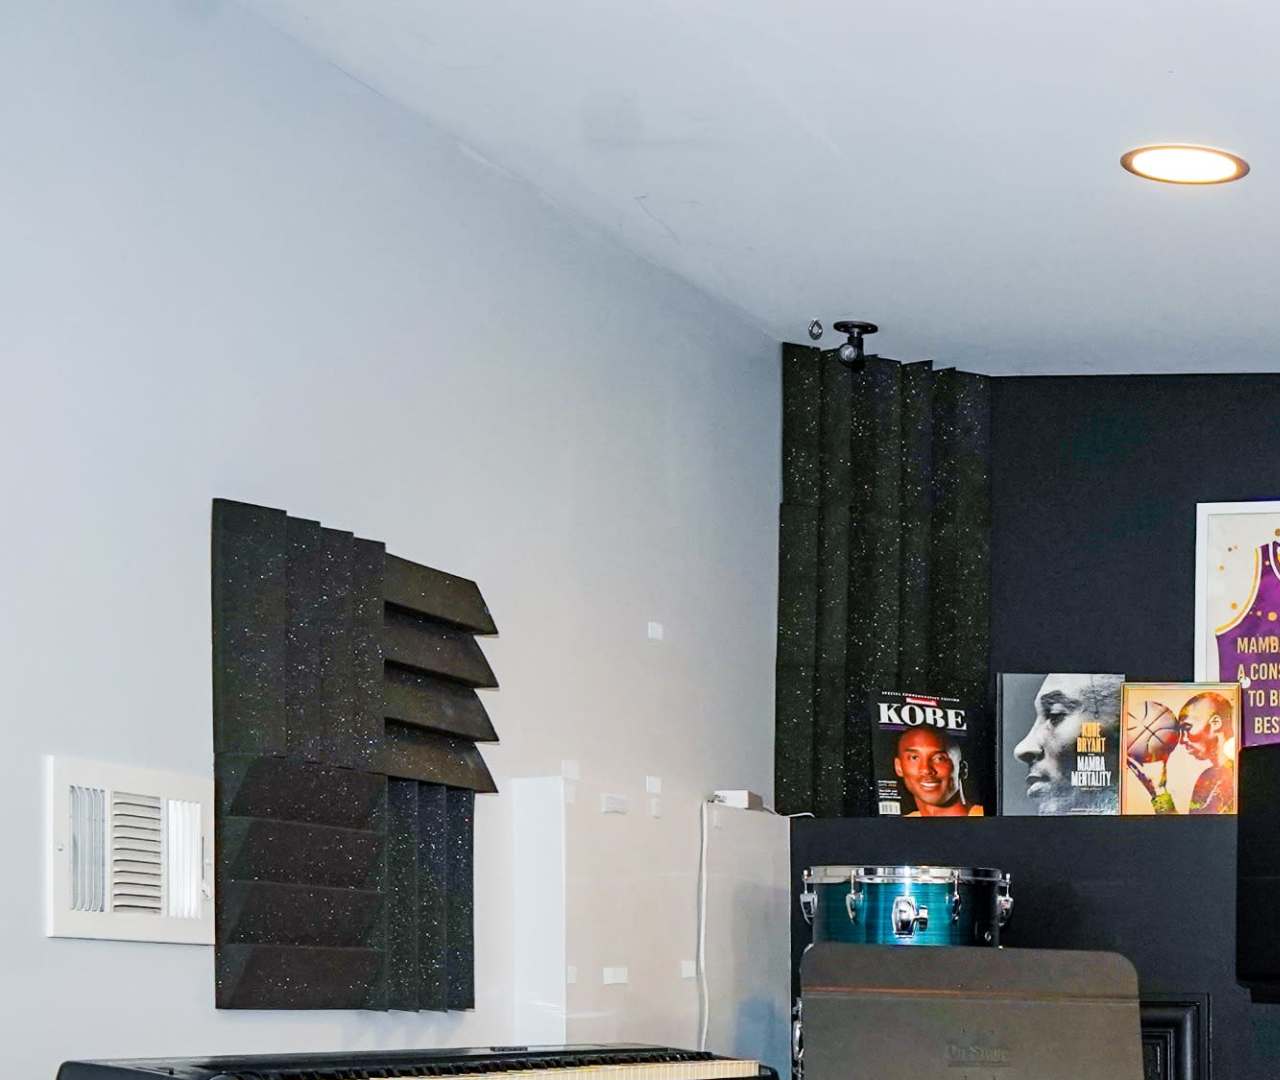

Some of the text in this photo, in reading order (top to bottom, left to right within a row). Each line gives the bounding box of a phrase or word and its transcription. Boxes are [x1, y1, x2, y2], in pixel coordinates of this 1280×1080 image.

[1237, 663, 1247, 681] A
[1248, 689, 1265, 708] TO
[877, 702, 968, 731] KOBE
[1076, 737, 1106, 753] BRYANT
[1077, 755, 1106, 771] MAMBA
[1070, 770, 1112, 787] MENTALITY
